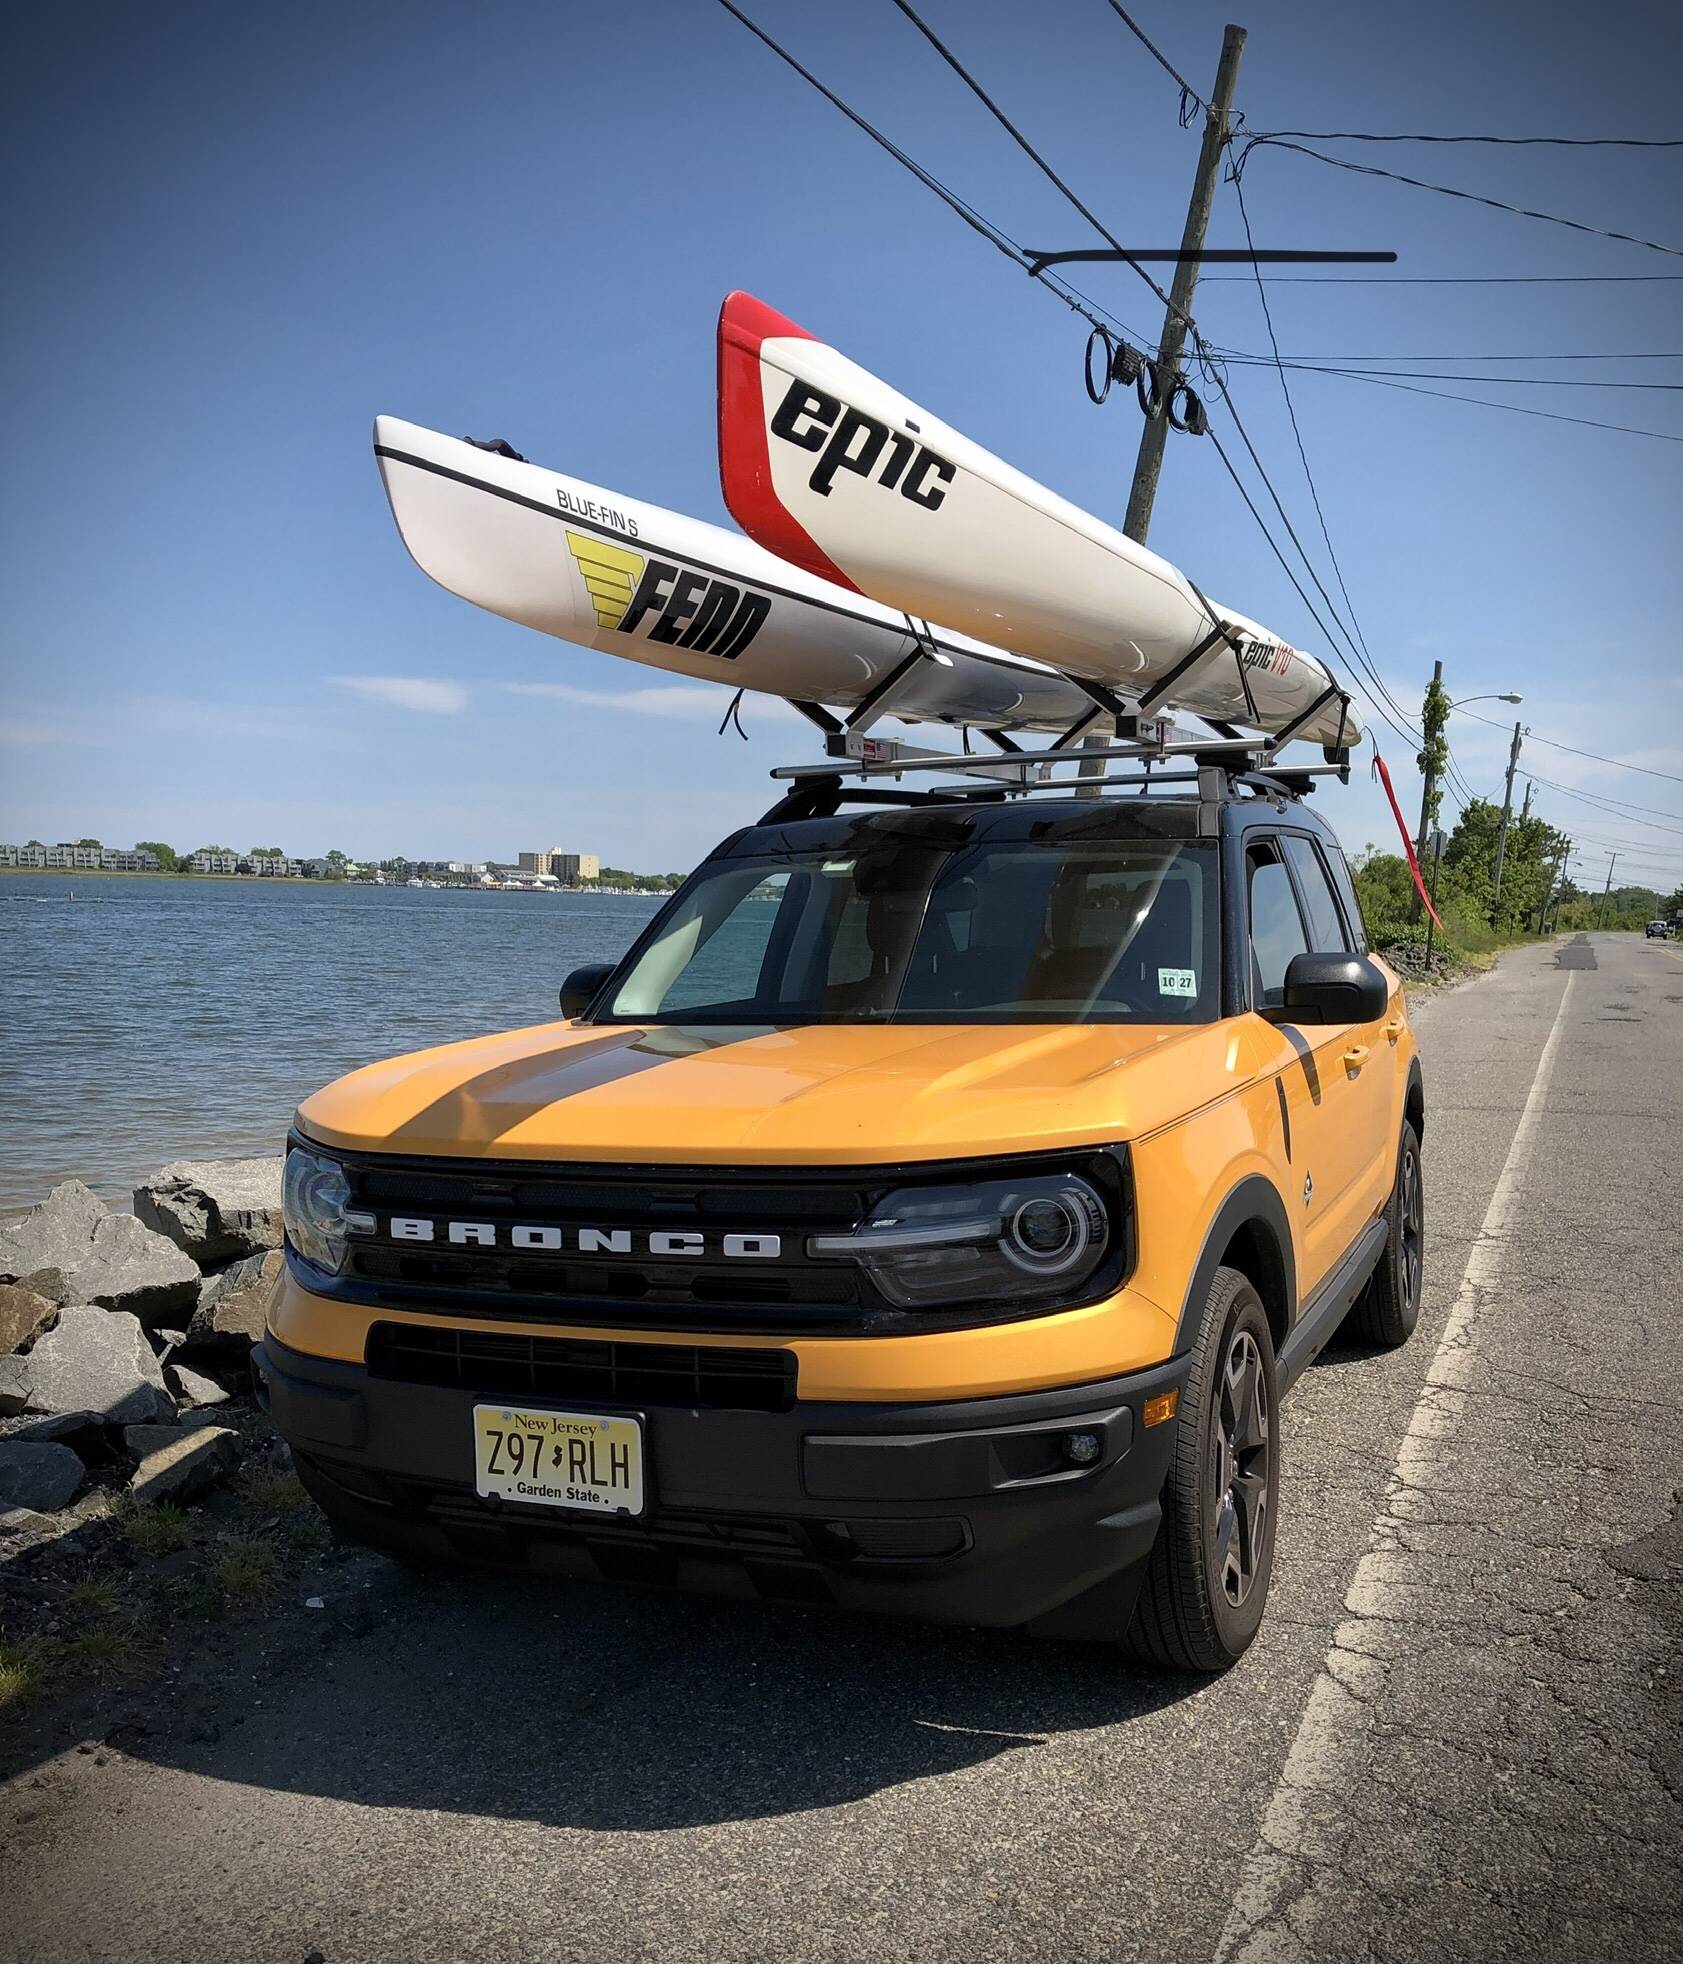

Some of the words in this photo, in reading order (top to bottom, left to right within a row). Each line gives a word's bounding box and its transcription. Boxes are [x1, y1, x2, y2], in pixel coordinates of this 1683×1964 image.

[771, 378, 957, 511] epic
[556, 489, 625, 530] BLUE-FIN
[629, 518, 639, 537] S
[617, 558, 772, 660] FENN
[1162, 976, 1175, 988] 10
[1180, 977, 1192, 988] 27
[390, 1217, 781, 1257] BRONCO
[514, 1414, 549, 1430] New
[551, 1418, 598, 1438] Jersey
[486, 1430, 545, 1479] Z97
[568, 1438, 630, 1489] RLH
[516, 1482, 562, 1499] Garden
[566, 1486, 600, 1503] State
